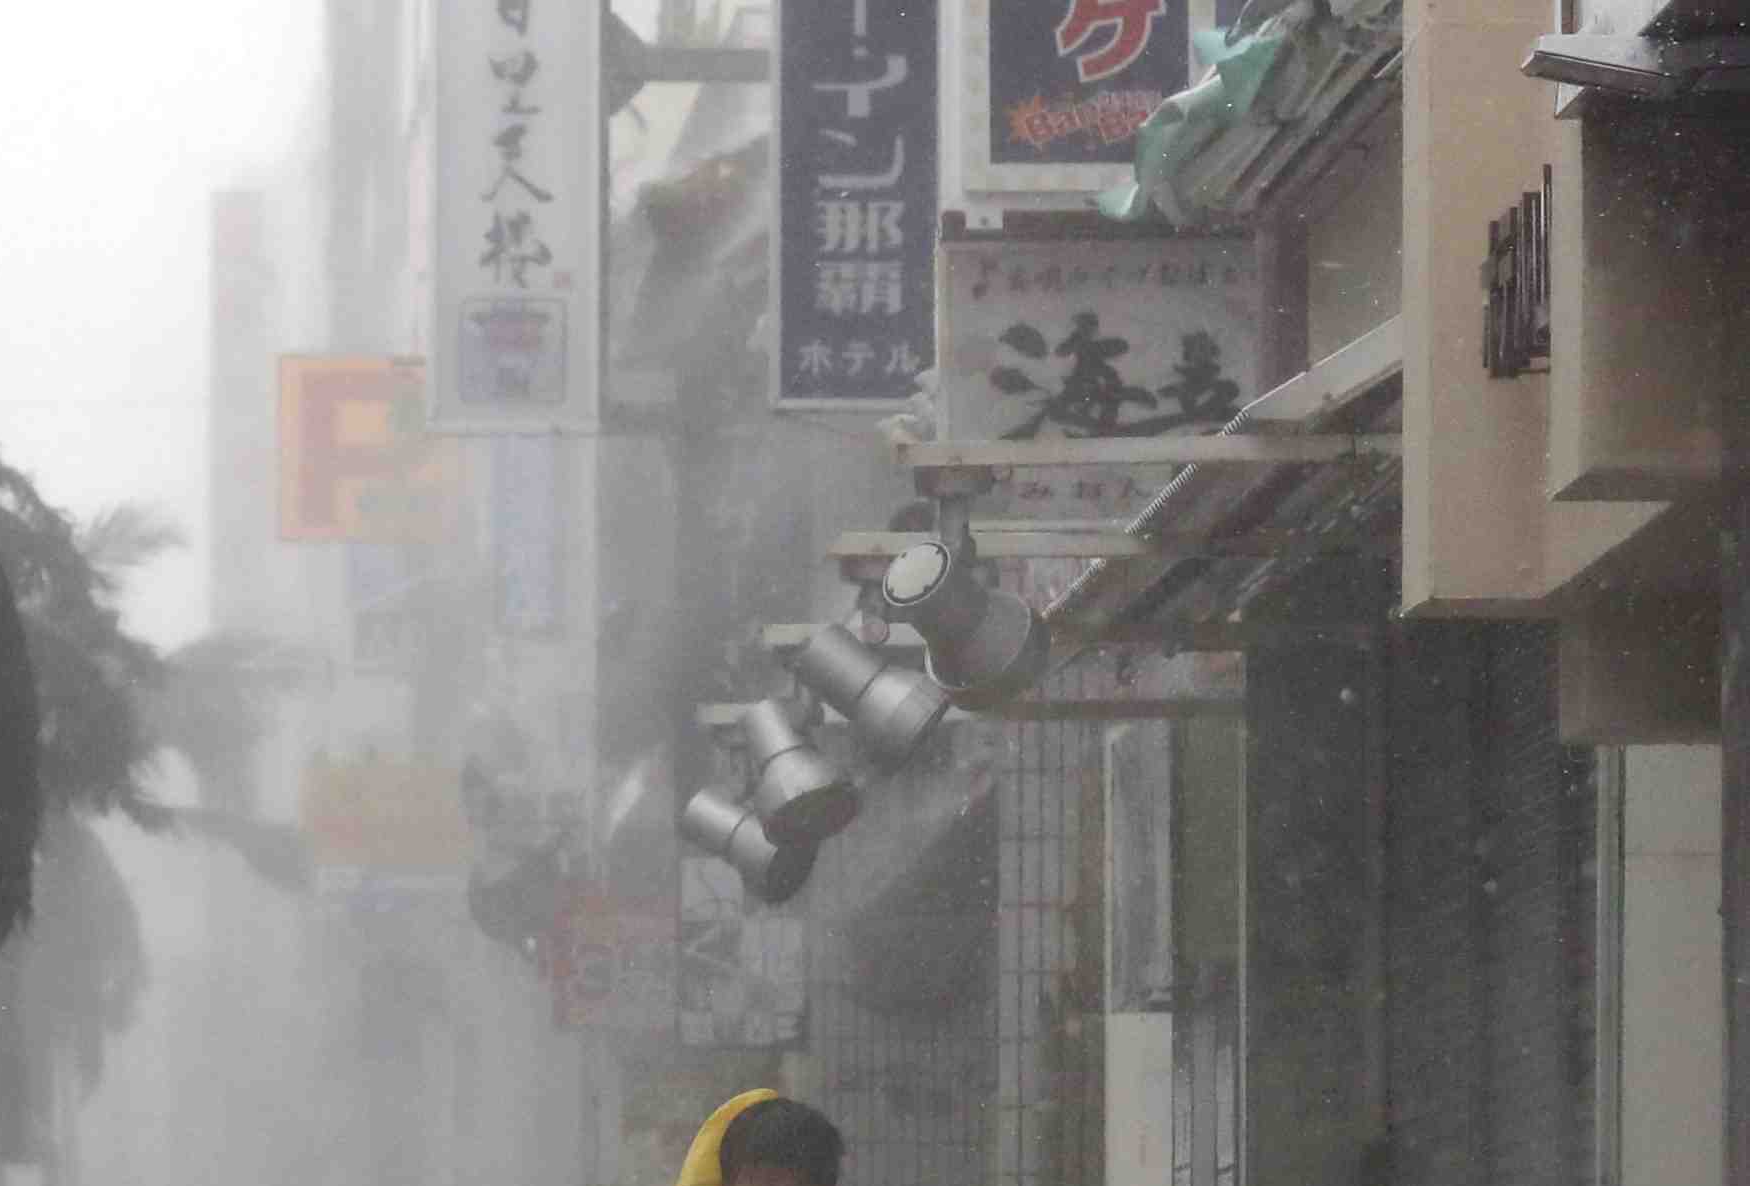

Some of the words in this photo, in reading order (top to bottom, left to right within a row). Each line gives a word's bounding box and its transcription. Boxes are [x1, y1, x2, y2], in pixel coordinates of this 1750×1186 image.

[799, 340, 919, 376] ホテル
[300, 370, 424, 526] P
